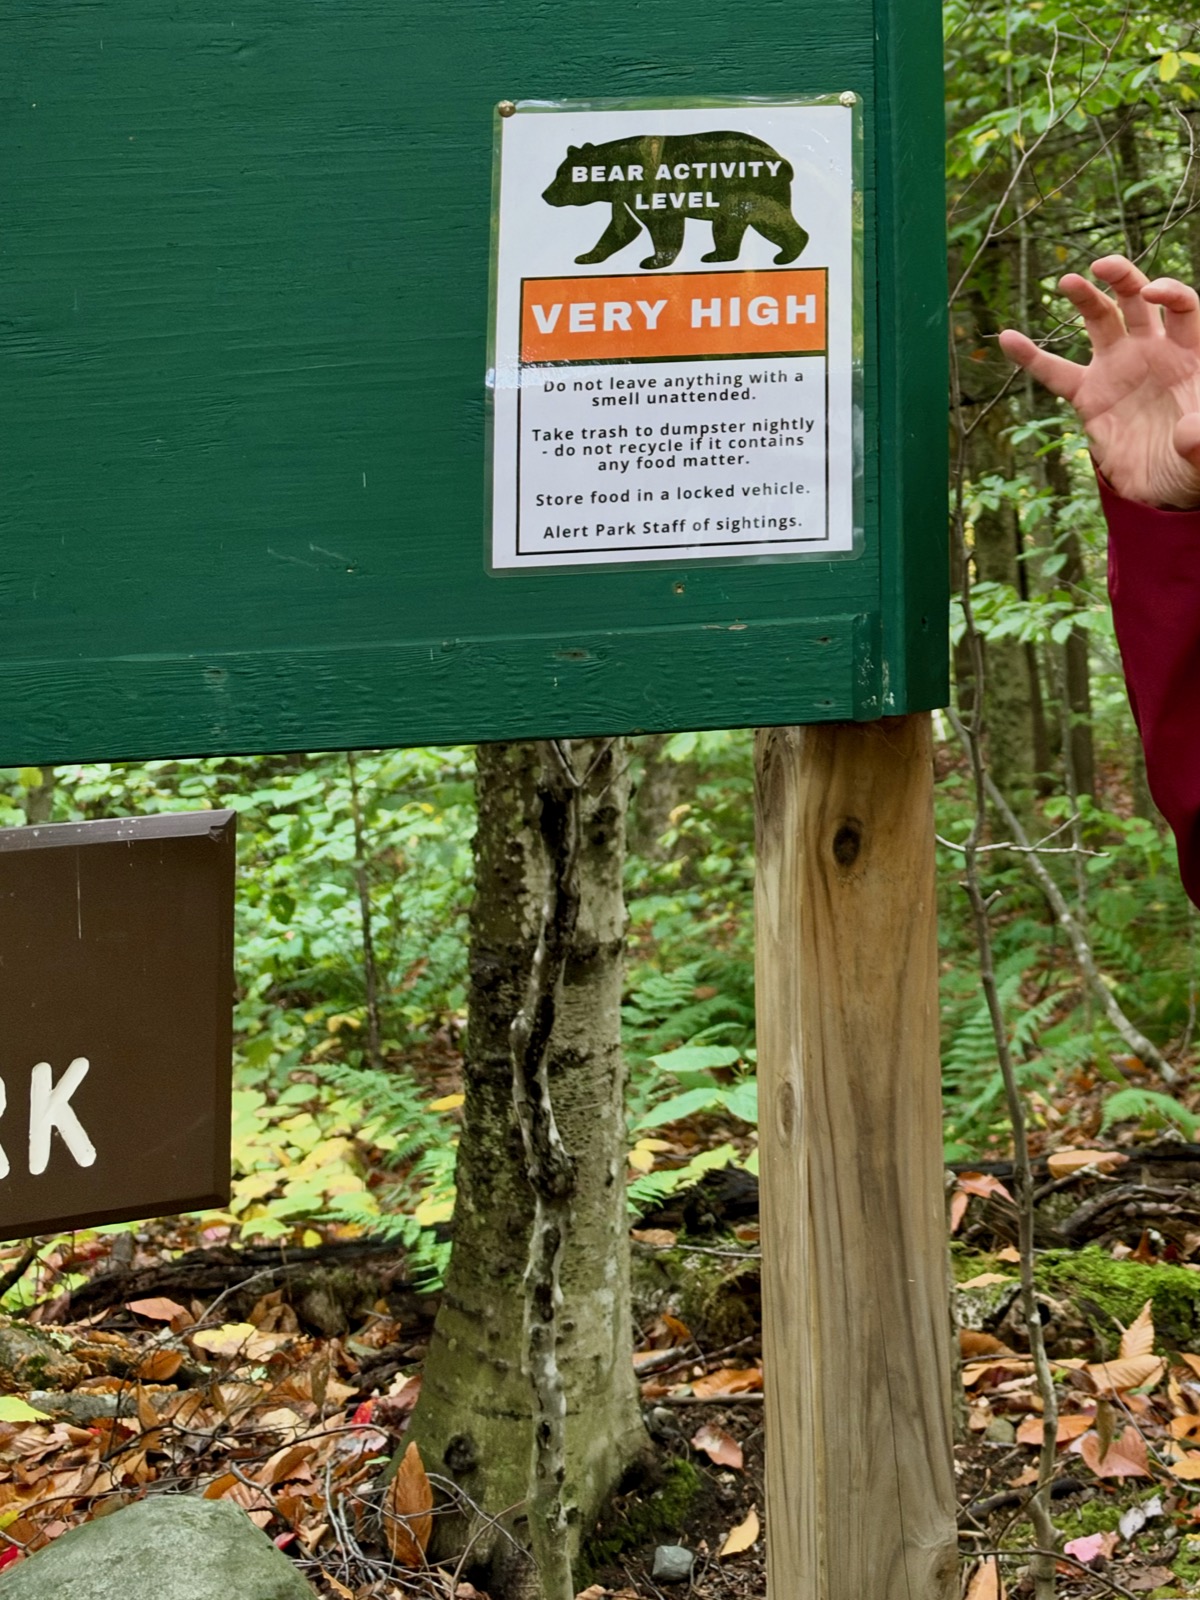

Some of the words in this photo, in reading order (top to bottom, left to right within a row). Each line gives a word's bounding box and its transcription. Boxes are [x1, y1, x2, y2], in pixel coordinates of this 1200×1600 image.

[572, 165, 644, 182] BEAR
[655, 161, 782, 180] ACTIVITY
[635, 192, 720, 210] LEVEL
[531, 300, 668, 334] VERY
[691, 294, 816, 329] HIGH
[544, 380, 566, 393] Do
[573, 377, 603, 392] not
[610, 375, 657, 390] leave
[664, 372, 743, 391] anything
[749, 370, 788, 384] with
[794, 372, 804, 383] a
[592, 392, 639, 407] smell
[647, 387, 756, 405] unattended.
[532, 427, 574, 442] Take
[581, 424, 628, 440] trash
[635, 424, 653, 437] to
[660, 420, 745, 441] dumpster
[753, 417, 814, 435] nightly
[554, 441, 575, 457] do
[583, 441, 612, 455] not
[620, 438, 683, 459] recycle
[690, 436, 703, 451] if
[709, 436, 721, 450] it
[728, 433, 804, 450] contains
[598, 459, 630, 473] any
[636, 454, 676, 470] food
[683, 452, 750, 467] matter.
[536, 492, 583, 507] Store
[590, 489, 630, 504] food
[637, 488, 653, 502] in
[660, 489, 669, 501] a
[677, 484, 735, 500] locked
[742, 482, 810, 497] vehicle.
[543, 524, 589, 539] Alert
[596, 522, 636, 536] Park
[643, 519, 686, 534] Staff
[692, 518, 710, 532] of
[716, 515, 802, 534] sightings.
